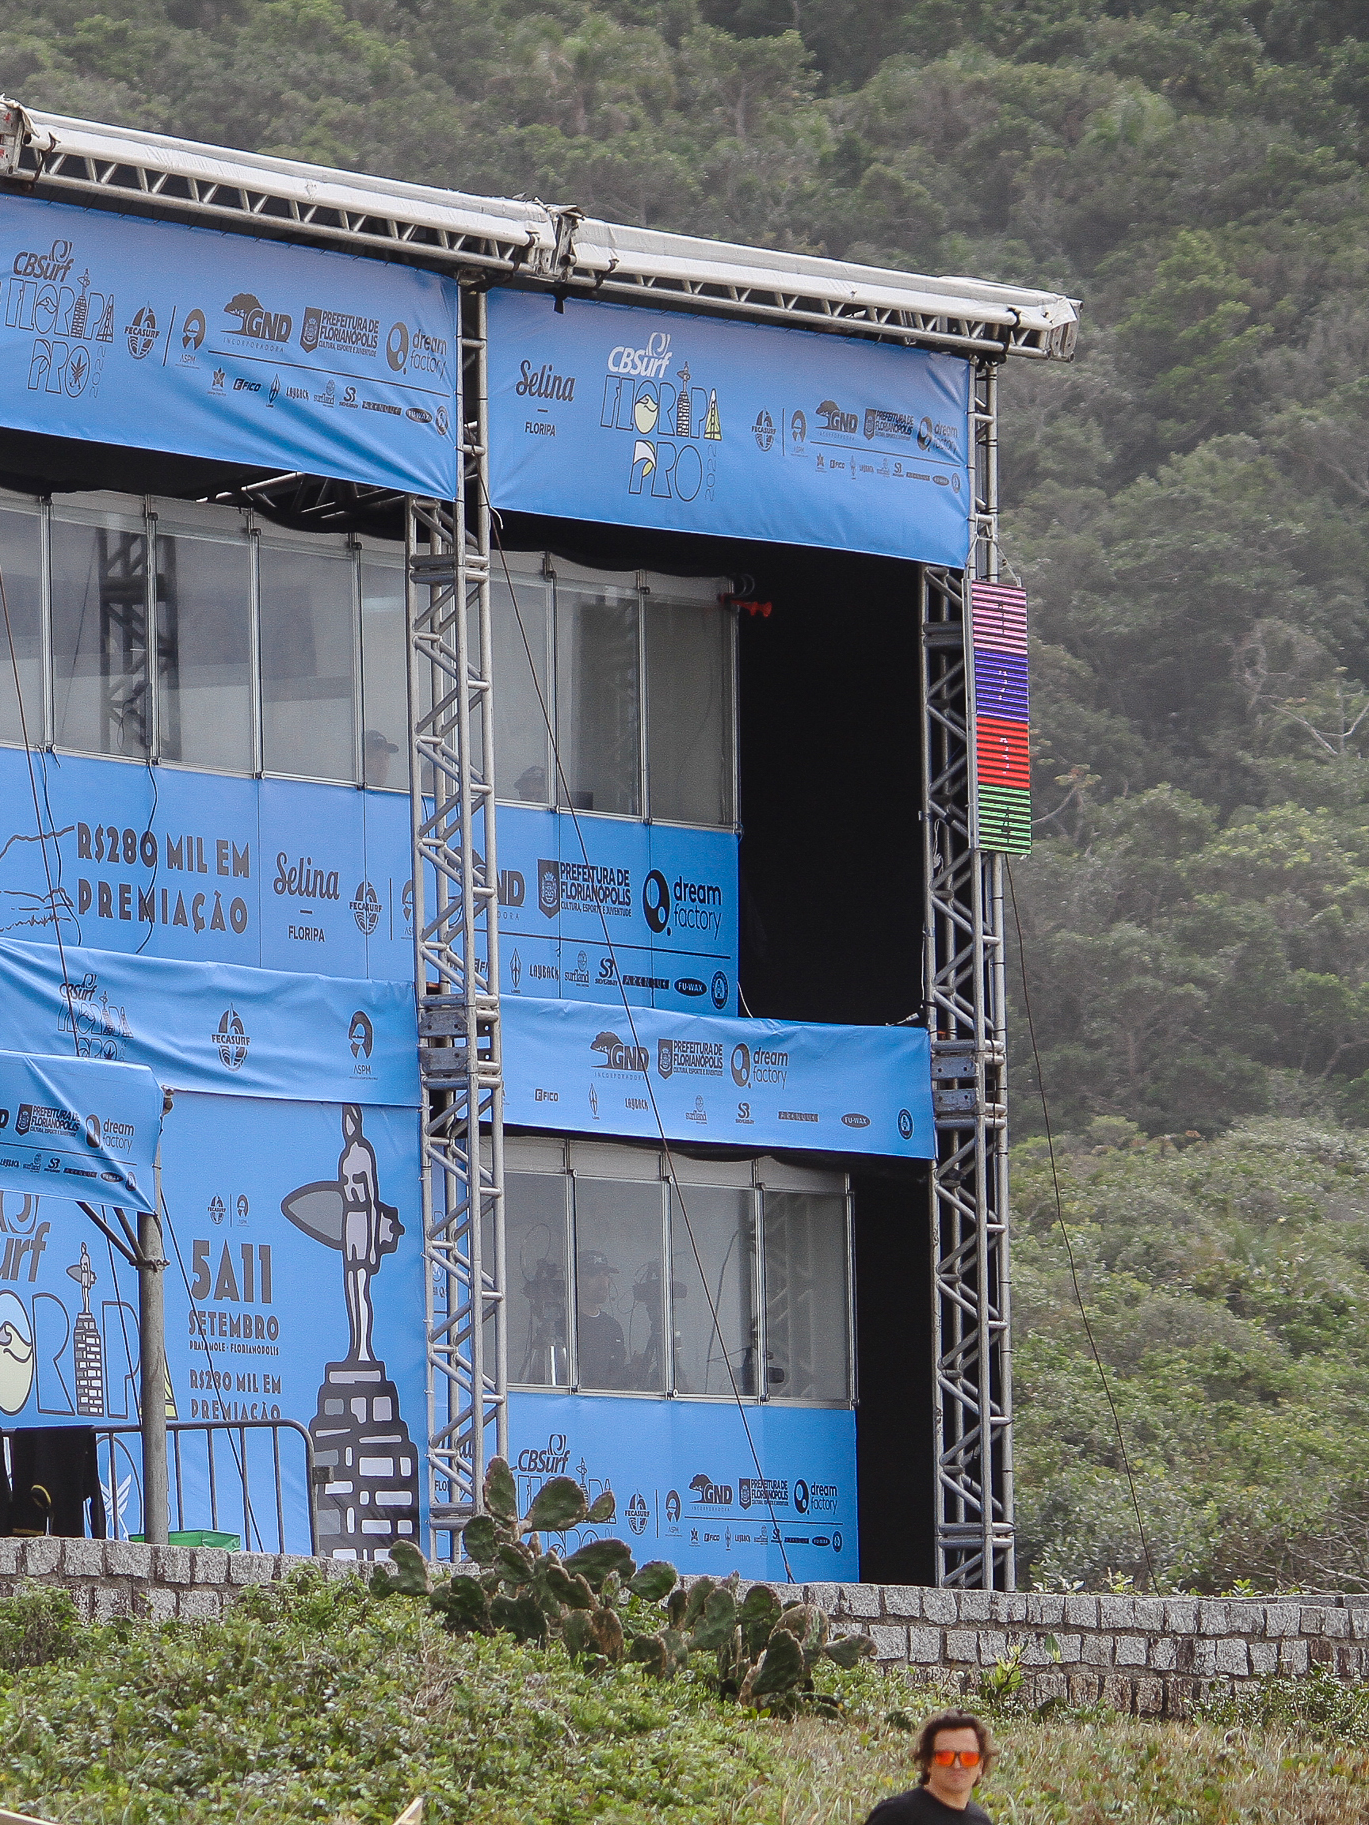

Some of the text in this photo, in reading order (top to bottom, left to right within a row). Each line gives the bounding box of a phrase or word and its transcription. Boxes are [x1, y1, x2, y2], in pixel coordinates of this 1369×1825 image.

[14, 252, 74, 282] CBSurf
[124, 326, 160, 339] FECASURF
[247, 308, 293, 342] GND
[322, 310, 379, 334] PREFEITURA DE
[412, 329, 447, 355] dream
[410, 350, 446, 380] factory
[608, 346, 672, 378] CBSurf
[516, 359, 575, 401] Selina
[525, 421, 556, 437] FLORIPA
[832, 410, 858, 433] GND
[629, 439, 702, 501] PRO
[78, 822, 250, 878] R$280 MIL EM
[273, 851, 340, 900] Selina
[560, 861, 630, 887] PREFEITURA DE
[560, 882, 631, 906] FLORIANÓPOLIS
[673, 875, 722, 906] dream
[78, 878, 248, 934] PREMIAÇÃO
[349, 902, 382, 912] FECASURF
[289, 925, 325, 942] FLORIPA
[673, 904, 722, 940] factory
[678, 981, 704, 993] FU-WAX
[211, 1033, 251, 1046] FECASURF
[673, 1039, 723, 1056] PREFEITURA DE
[612, 1045, 649, 1071] GND
[753, 1046, 788, 1067] dream
[353, 1064, 371, 1075] ASPM
[752, 1065, 788, 1090] factory
[32, 1105, 71, 1121] PREFEITURA
[103, 1118, 135, 1136] dream
[189, 1309, 280, 1341] SETEMBRO
[236, 1372, 259, 1393] MIL
[264, 1374, 281, 1395] EM
[518, 1449, 570, 1474] CBSurf
[704, 1483, 733, 1505] GND
[811, 1482, 838, 1496] dream
[811, 1497, 838, 1515] factory
